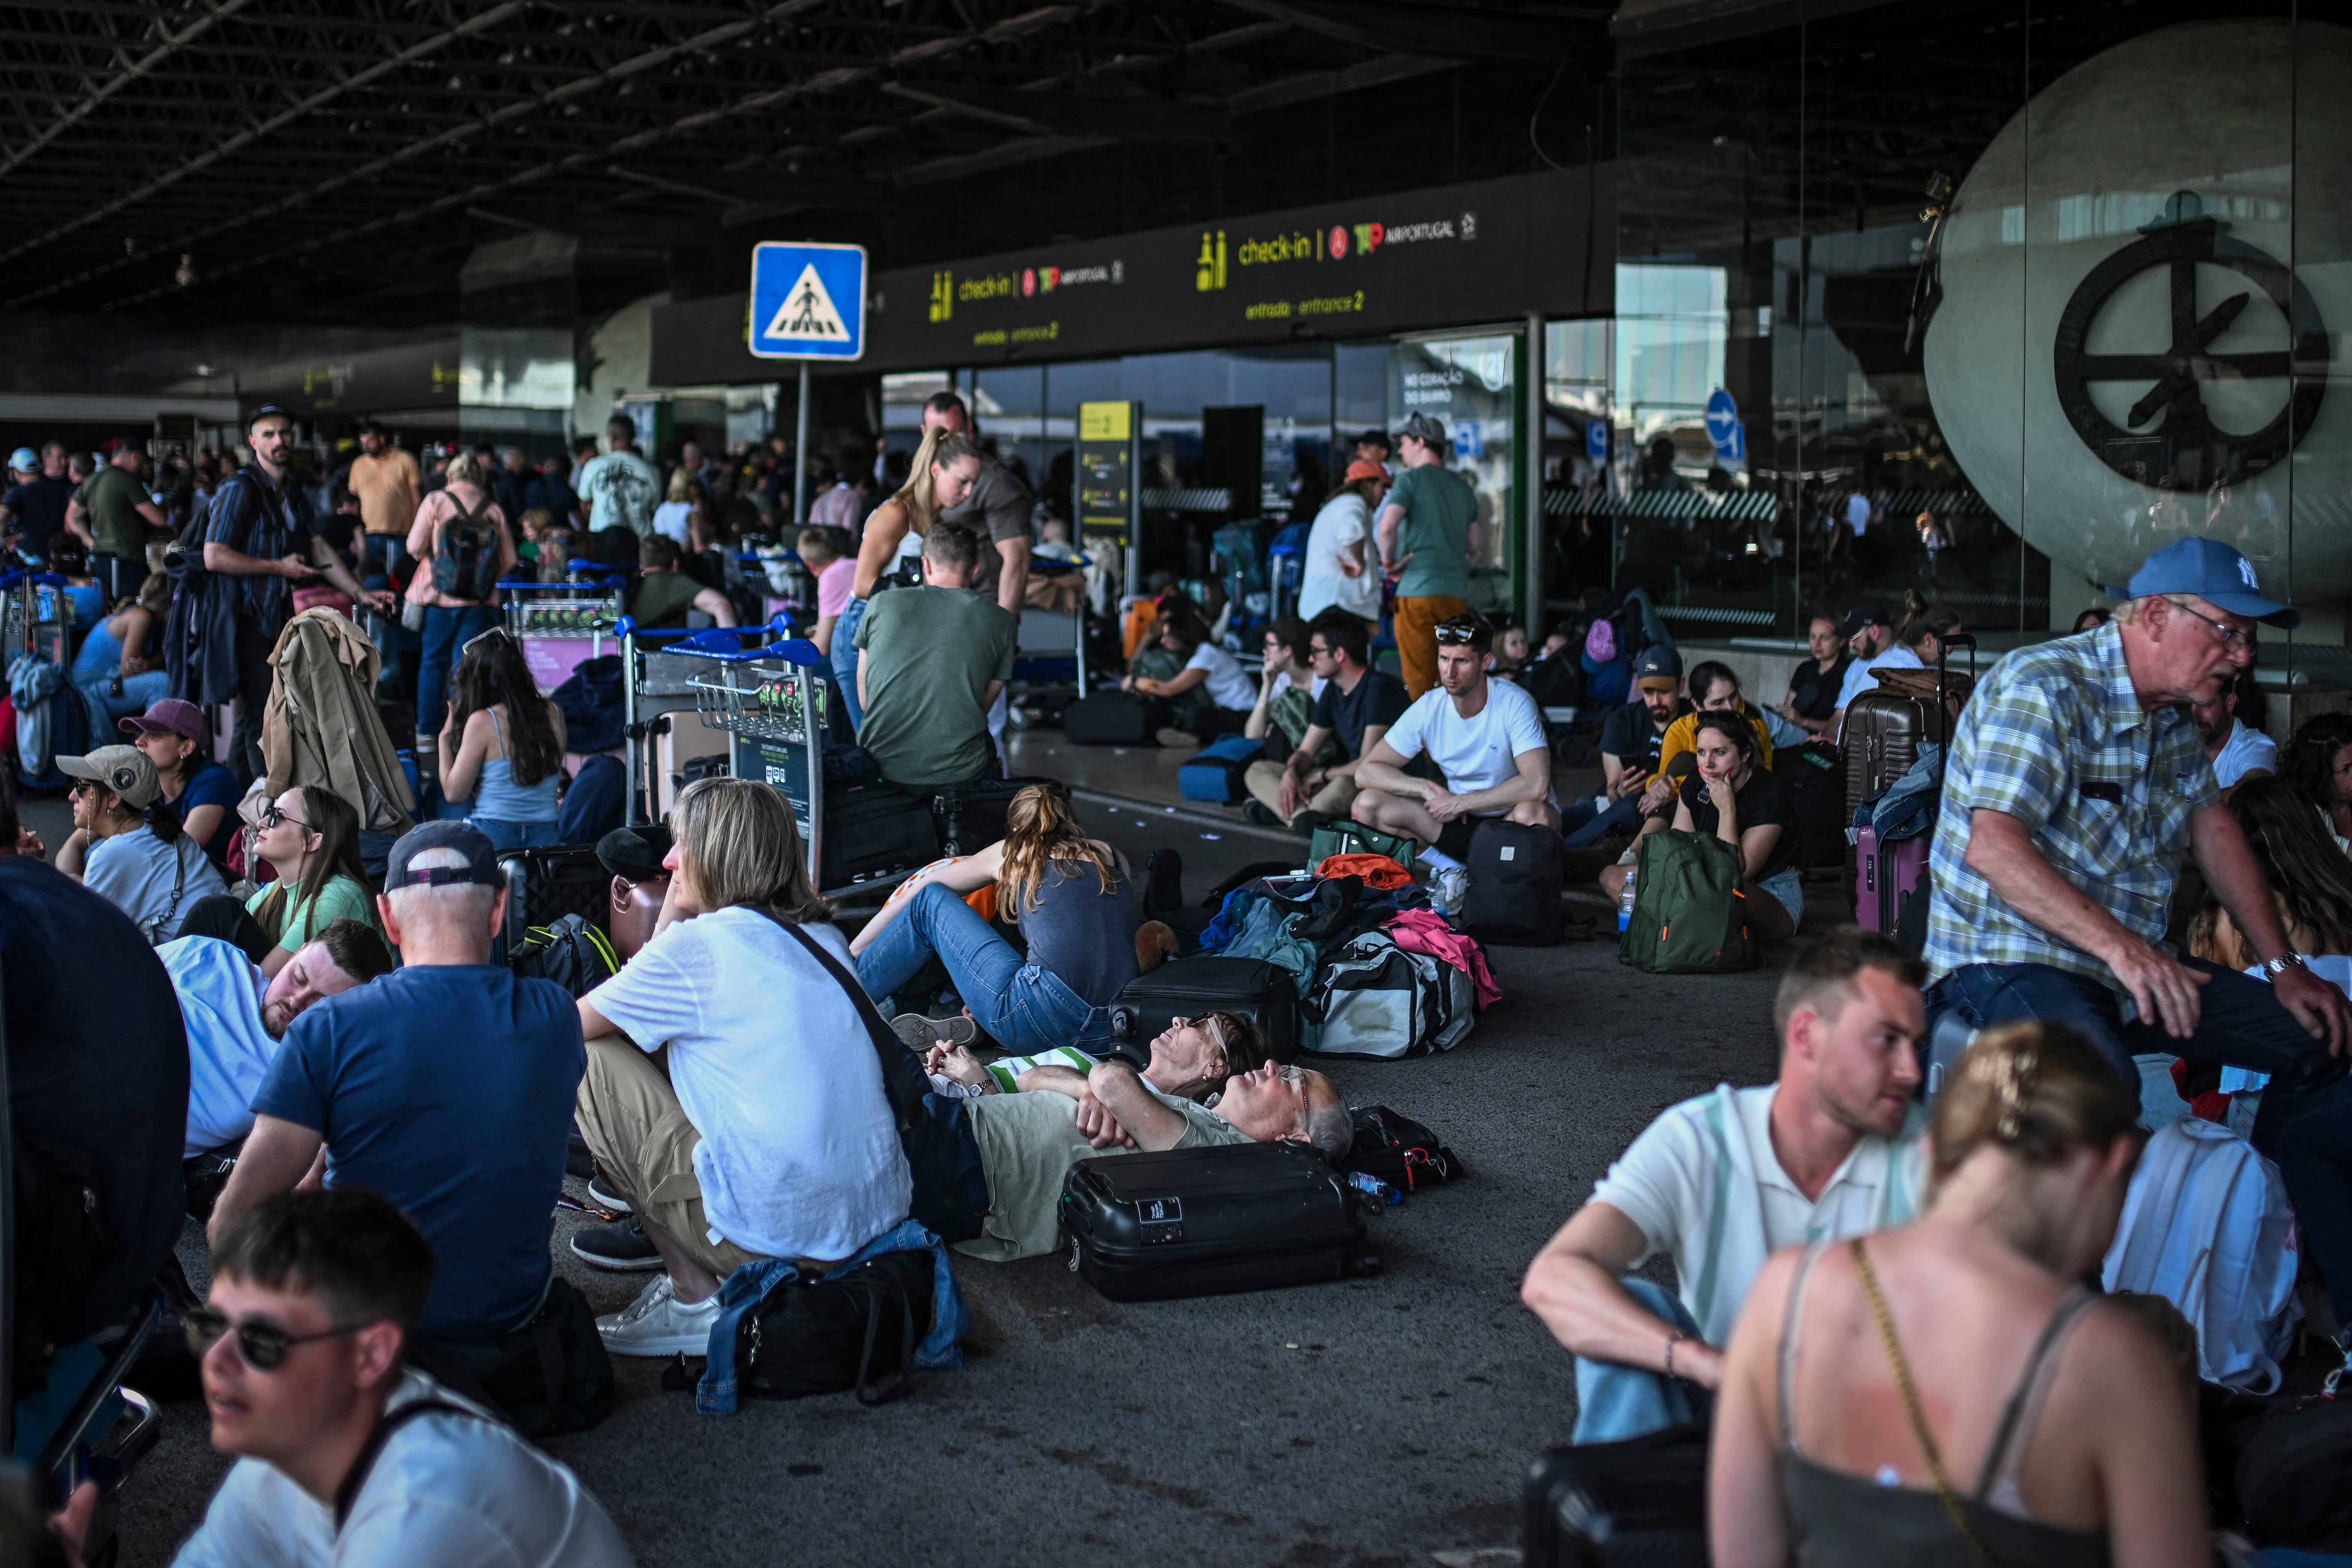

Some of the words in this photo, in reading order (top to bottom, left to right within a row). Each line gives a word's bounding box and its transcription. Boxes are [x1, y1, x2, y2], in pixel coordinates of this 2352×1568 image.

[1239, 231, 1311, 265] check-in
[1353, 222, 1385, 257] TAP
[959, 272, 1012, 302] check-in
[1245, 299, 1292, 320] entrada
[1298, 295, 1353, 316] entrance
[1353, 290, 1365, 311] 2
[1050, 321, 1060, 339] 2
